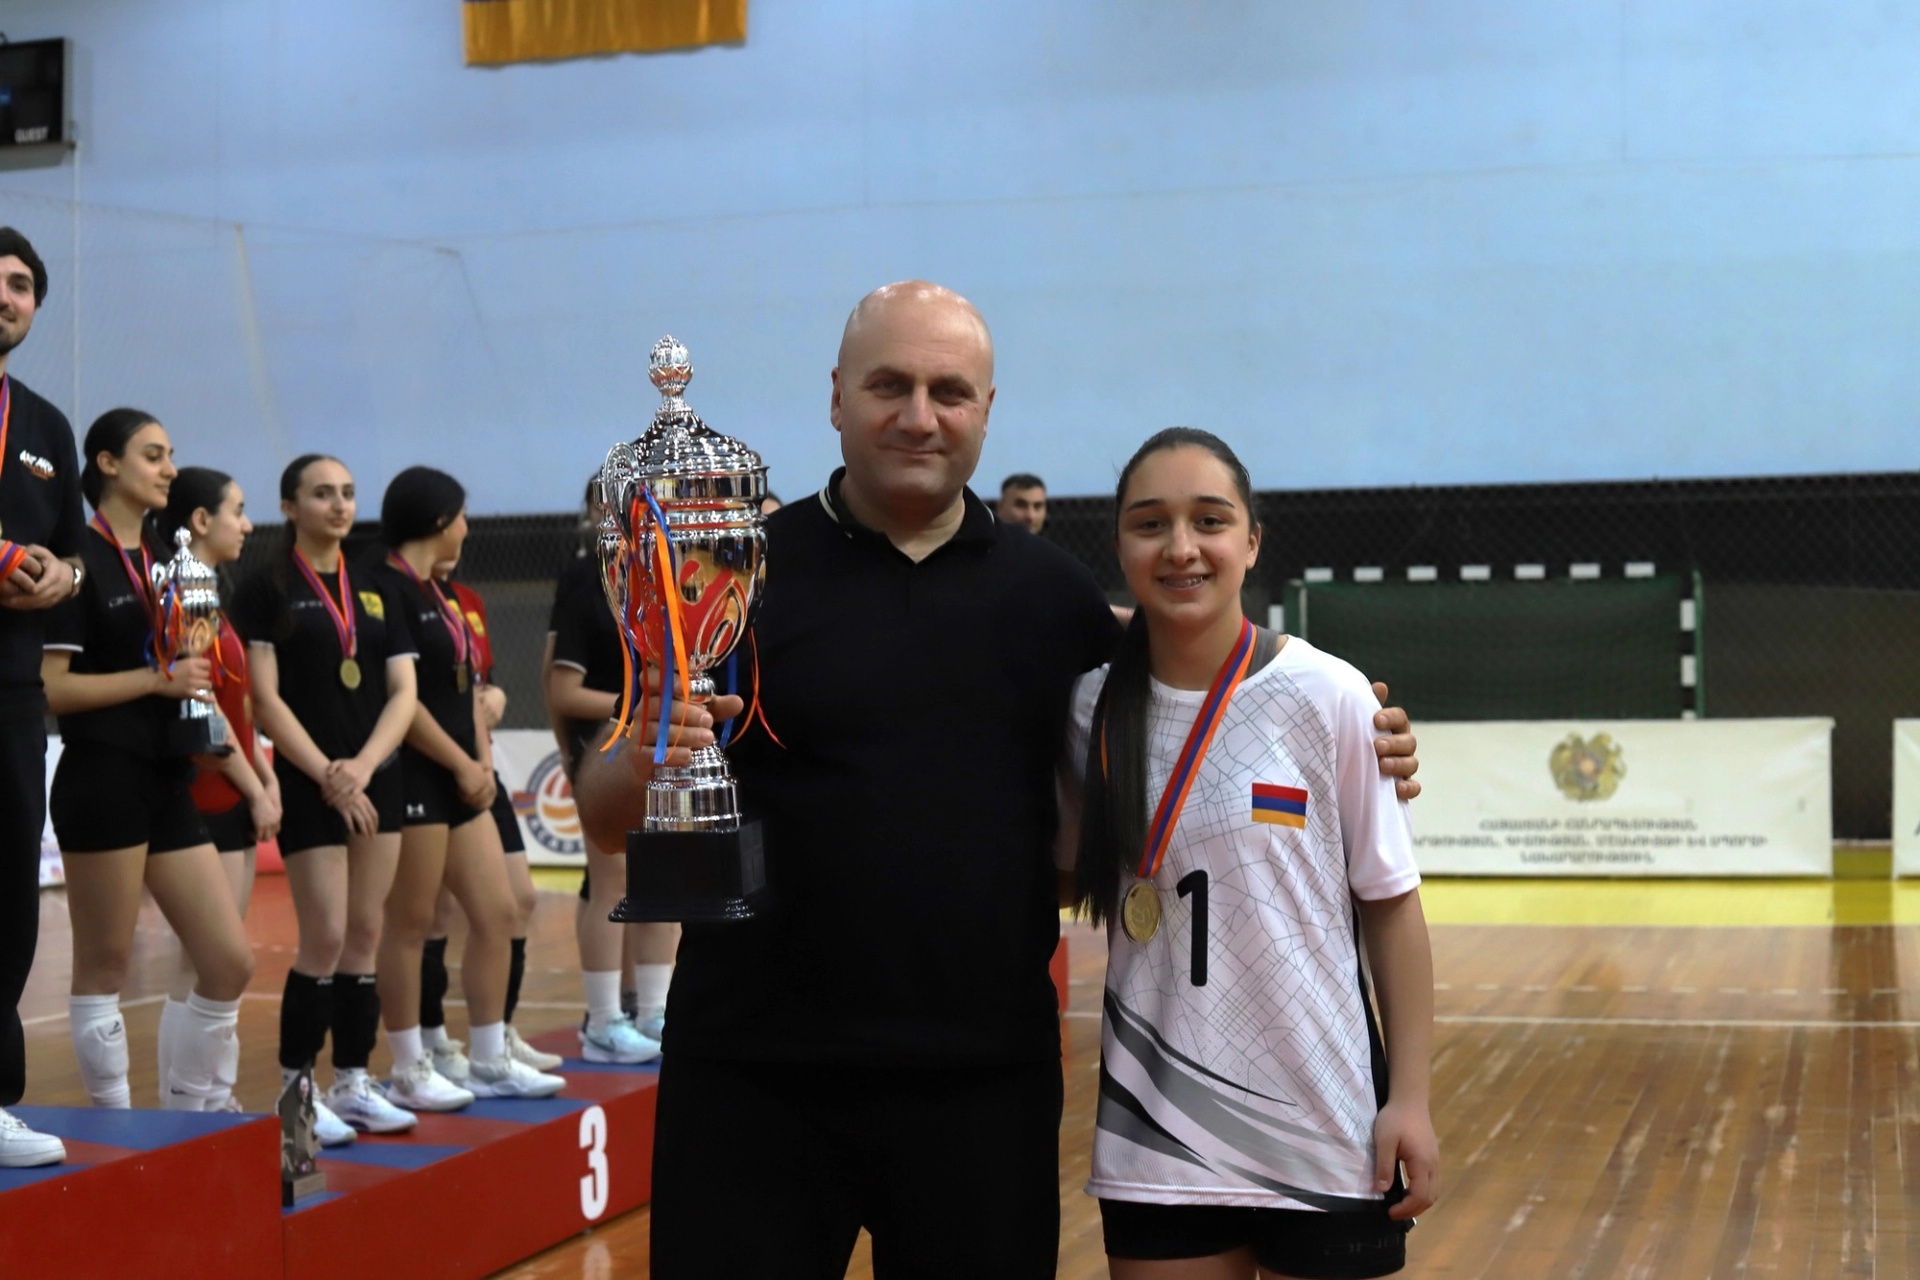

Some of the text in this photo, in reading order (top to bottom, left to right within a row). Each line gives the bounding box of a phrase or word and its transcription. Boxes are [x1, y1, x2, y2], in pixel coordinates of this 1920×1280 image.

[14, 126, 49, 143] GUEST
[1176, 869, 1208, 987] 1
[579, 1105, 609, 1220] 3
